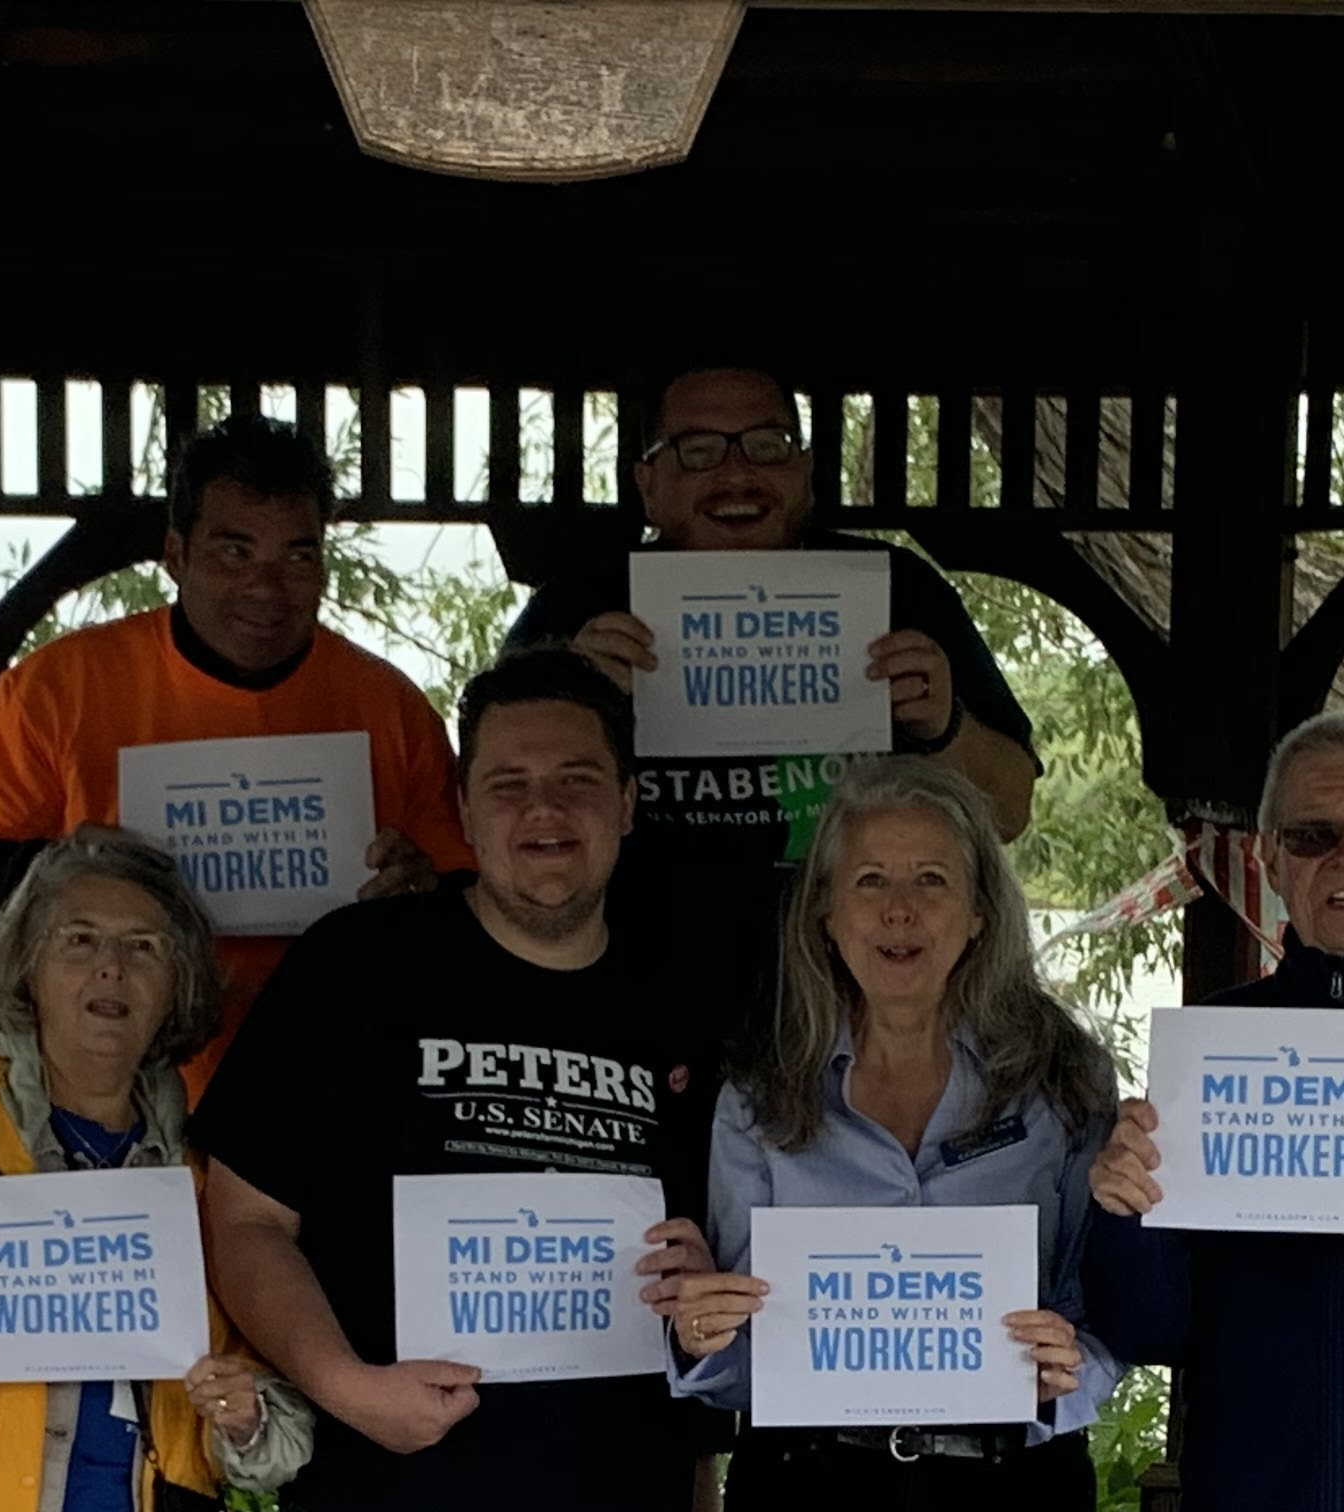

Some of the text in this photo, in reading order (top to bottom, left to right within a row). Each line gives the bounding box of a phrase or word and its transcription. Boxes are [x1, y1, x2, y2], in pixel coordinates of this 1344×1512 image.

[683, 611, 840, 639] MI DEMS
[683, 645, 839, 658] STAND WITH MI
[685, 663, 839, 707] WORKERS
[639, 754, 850, 802] STABENO
[165, 795, 325, 828] MI DEMS
[685, 810, 771, 825] SENATOR
[777, 809, 802, 822] for
[166, 828, 327, 847] STAND WITH MI
[417, 1037, 656, 1113] PETERS
[1203, 1075, 1247, 1102] MI
[453, 1101, 646, 1145] U.S. SENATE
[1202, 1112, 1274, 1125] STAND
[1288, 1113, 1344, 1127] WITH
[44, 1233, 153, 1266] DEMS
[449, 1236, 615, 1265] MI DEMS
[69, 1270, 122, 1284] WITH
[134, 1269, 156, 1280] MI
[449, 1271, 613, 1284] STAND WITH MI
[809, 1273, 983, 1300] MI DEMS
[450, 1289, 612, 1333] WORKERS
[808, 1308, 983, 1320] STAND WITH MI
[811, 1327, 982, 1371] WORKERS
